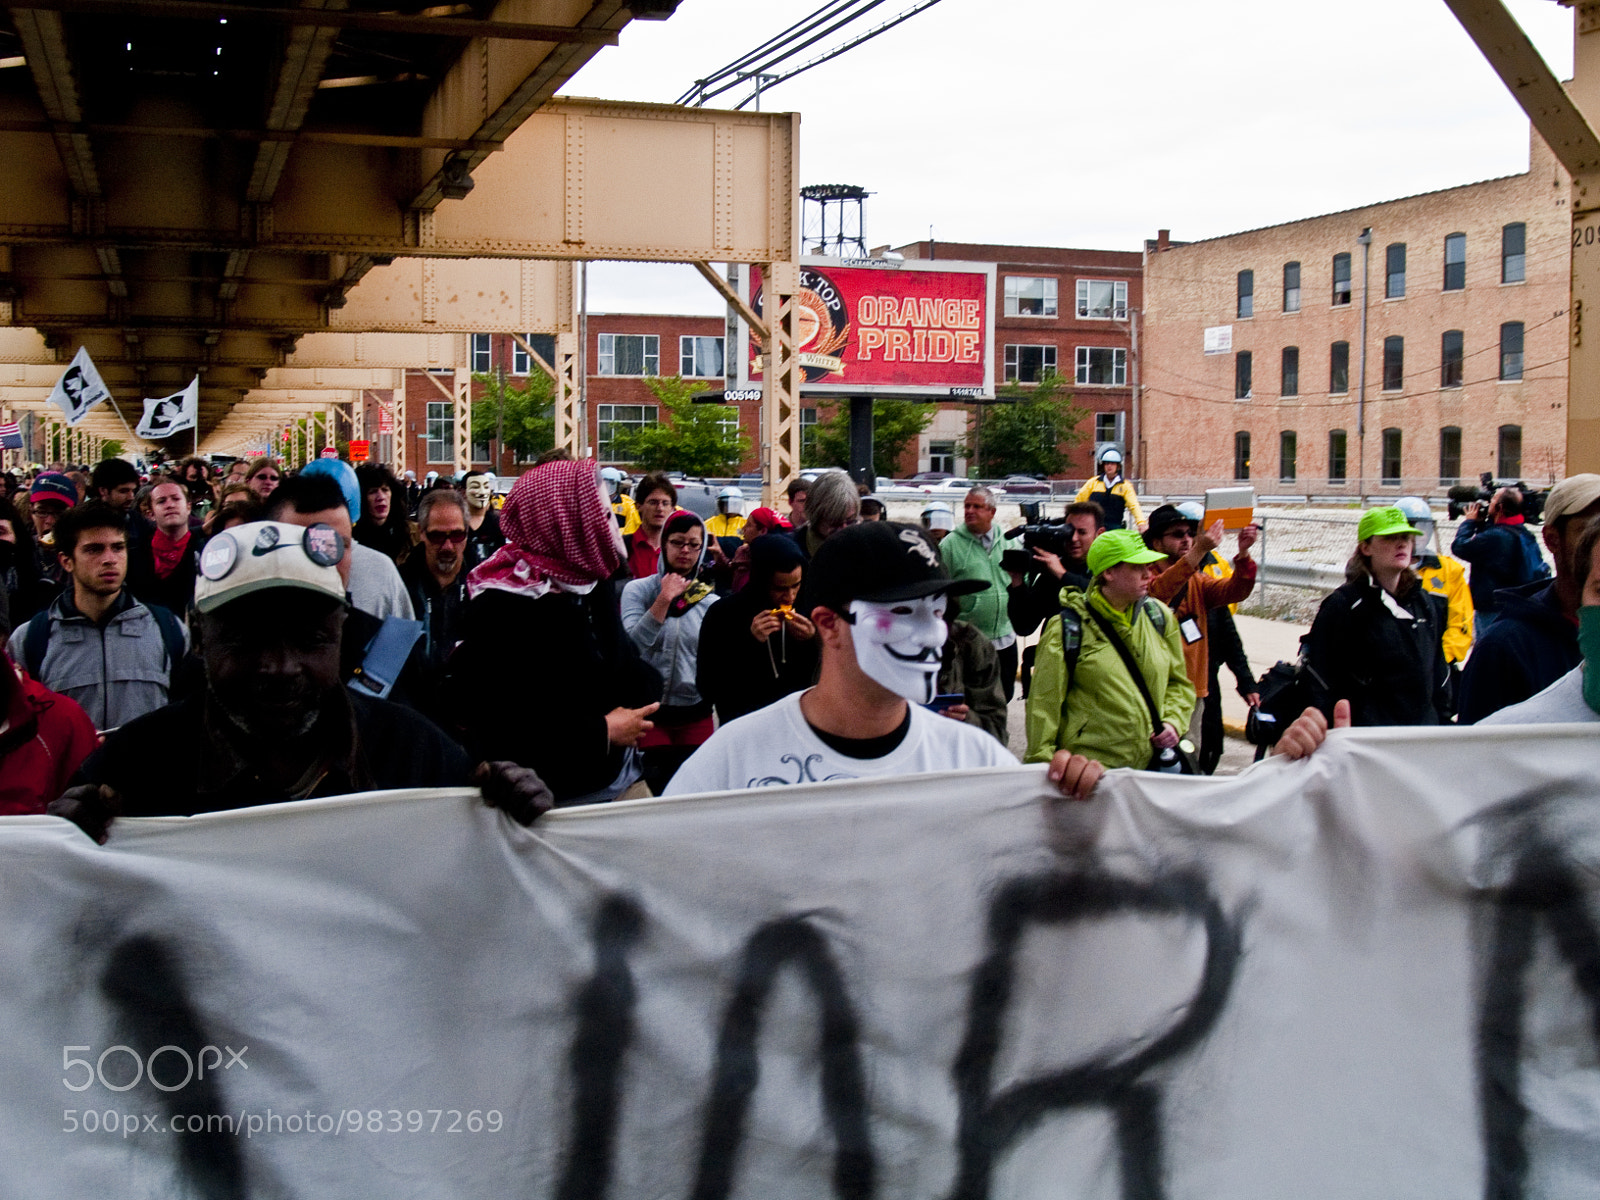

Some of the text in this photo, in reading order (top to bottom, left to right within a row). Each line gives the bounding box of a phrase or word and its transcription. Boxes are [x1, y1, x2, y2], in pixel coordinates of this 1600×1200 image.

[814, 276, 841, 311] TOP
[857, 295, 980, 329] ORANGE
[857, 328, 980, 364] PRIDE
[724, 390, 761, 401] 005149
